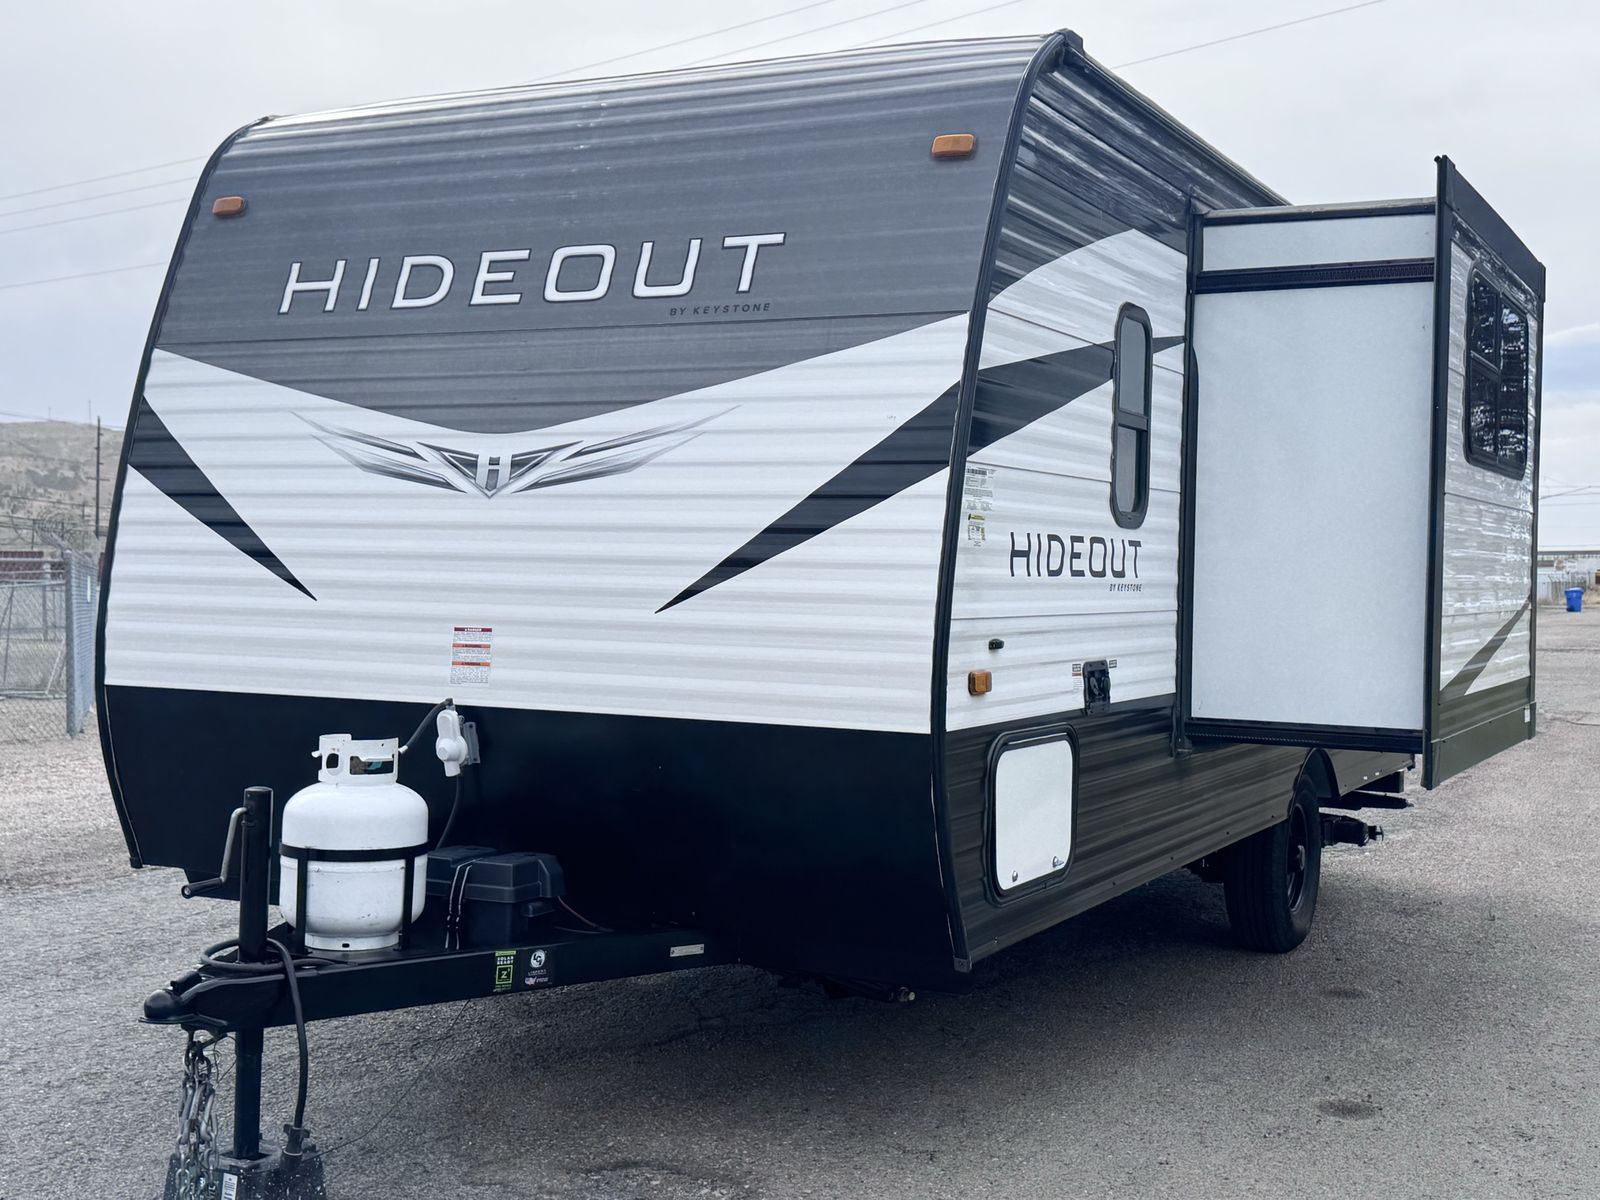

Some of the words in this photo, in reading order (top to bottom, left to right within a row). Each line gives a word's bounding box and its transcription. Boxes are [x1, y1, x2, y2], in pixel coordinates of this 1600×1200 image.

[278, 232, 787, 315] HIDEOUT
[669, 307, 687, 317] BY
[692, 302, 771, 316] KEYSTONE
[1009, 531, 1142, 579] HIDEOUT
[1109, 583, 1116, 592] BY
[1117, 583, 1143, 592] KEYSTONE
